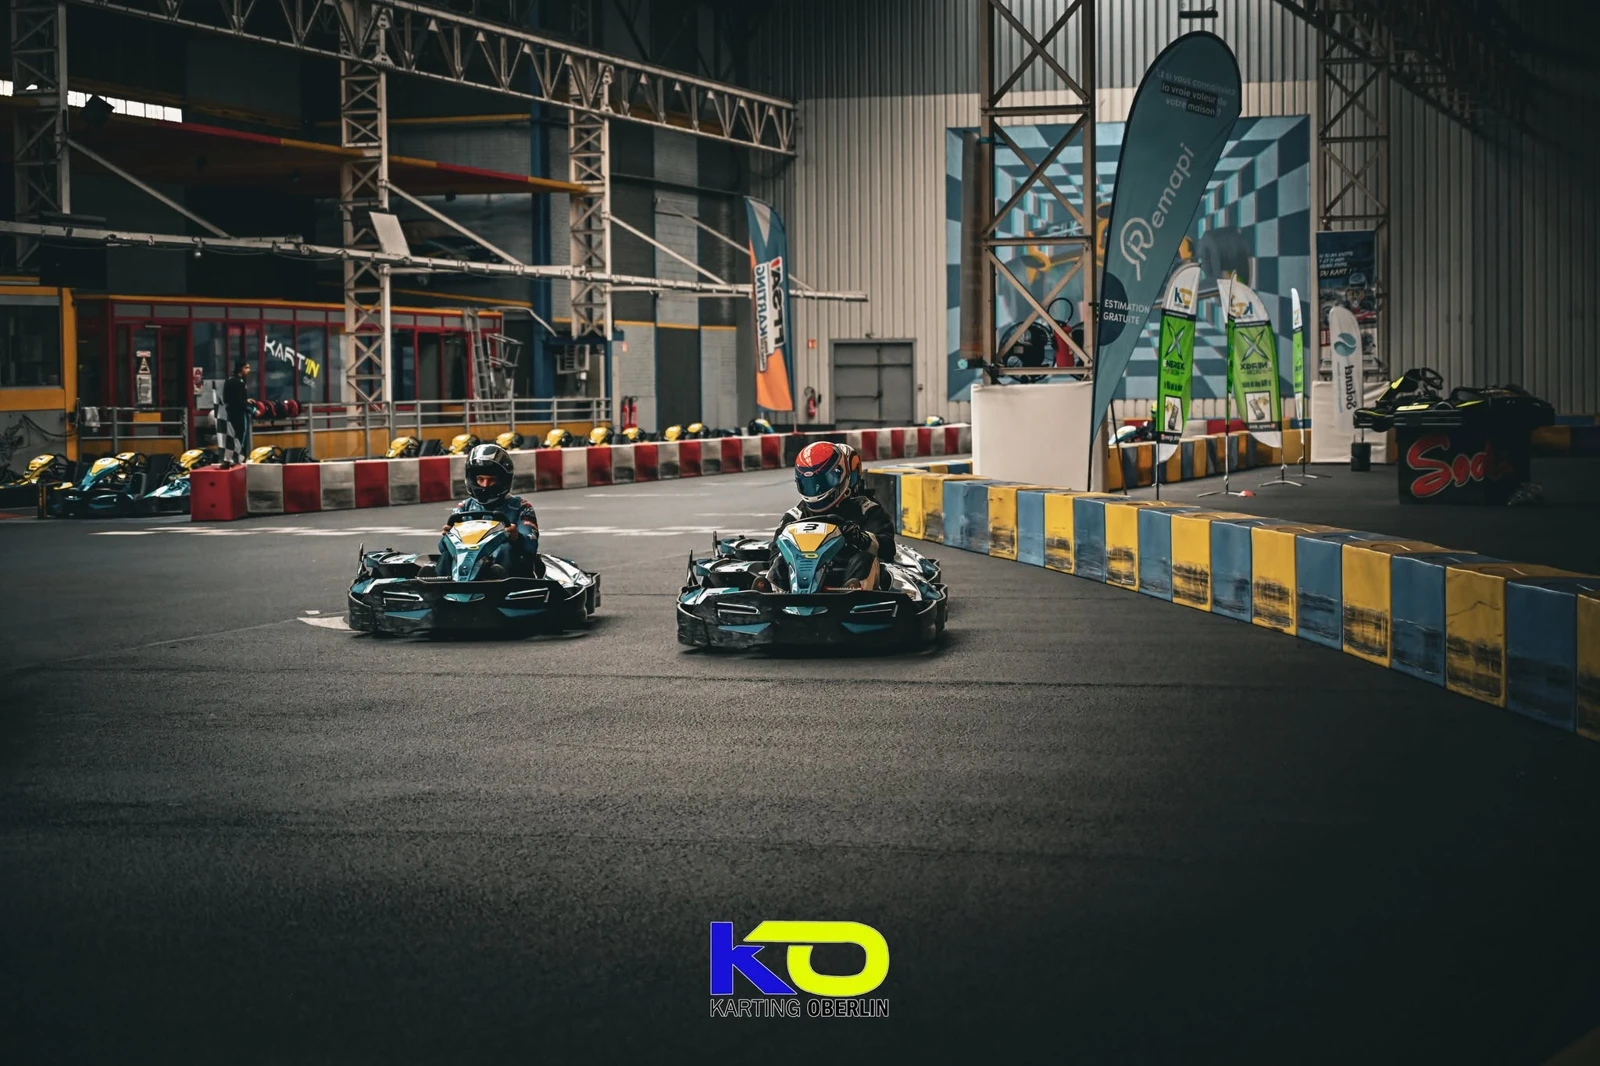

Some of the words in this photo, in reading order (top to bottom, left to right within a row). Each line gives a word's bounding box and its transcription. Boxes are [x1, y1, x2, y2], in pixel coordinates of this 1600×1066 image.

[1173, 74, 1191, 85] vous
[1162, 82, 1170, 92] la
[1171, 85, 1191, 98] vraie
[1192, 91, 1217, 104] valeur
[1217, 97, 1228, 107] de
[1165, 97, 1187, 109] votre
[1187, 103, 1216, 116] maison
[1104, 299, 1150, 314] ESTIMATION
[1103, 311, 1140, 326] GRATUITE
[803, 523, 819, 531] 3
